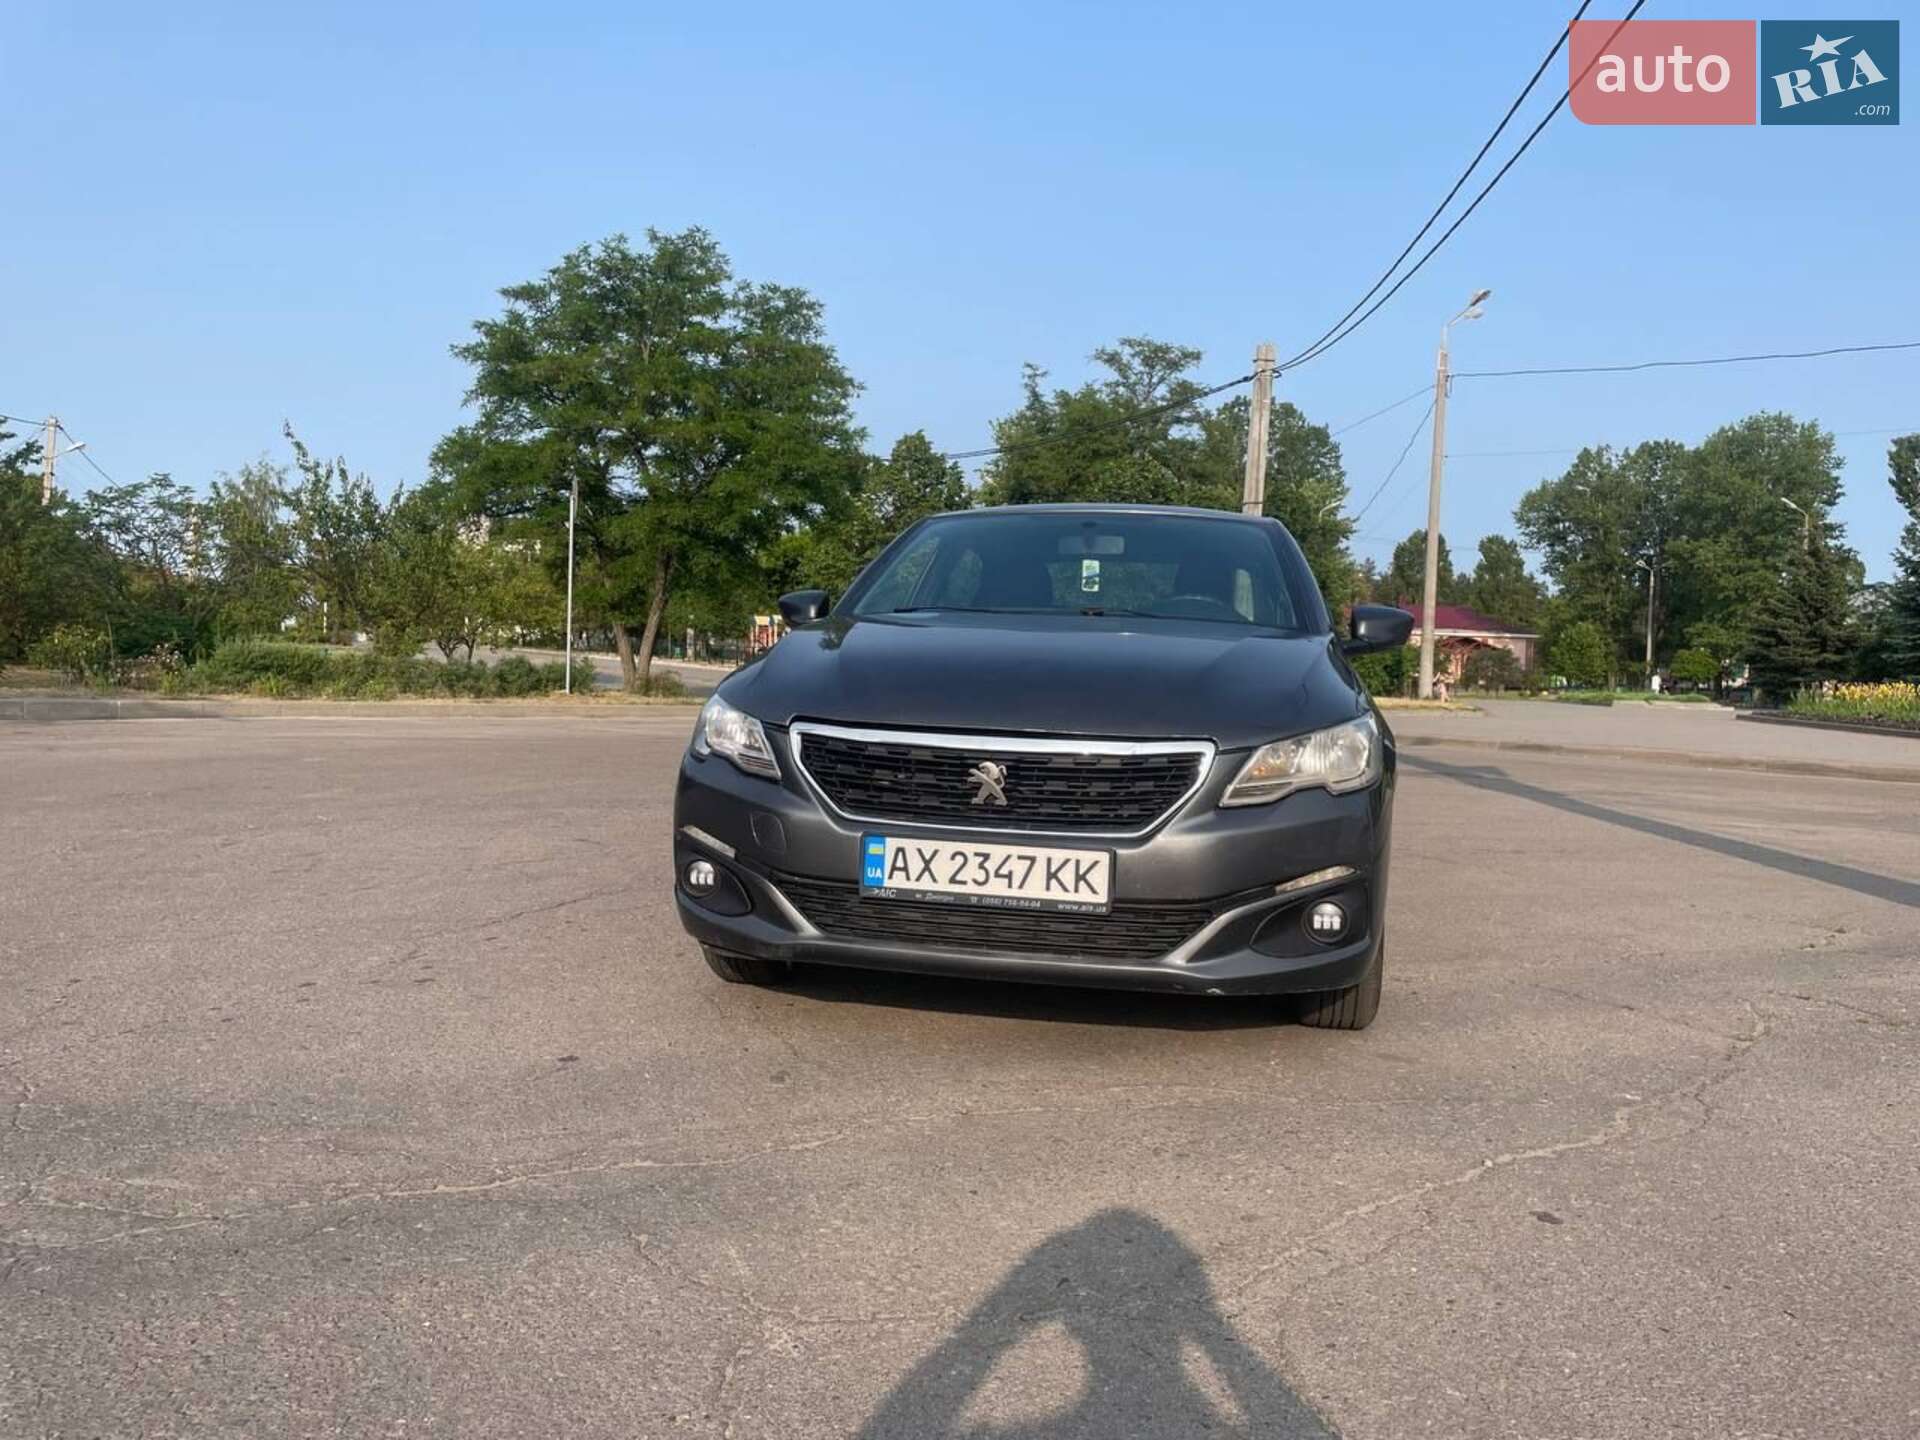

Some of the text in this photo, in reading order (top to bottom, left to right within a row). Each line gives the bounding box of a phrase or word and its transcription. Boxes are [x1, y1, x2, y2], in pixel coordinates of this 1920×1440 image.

[867, 866, 883, 879] UA
[888, 846, 1101, 894] AX 2347 KK
